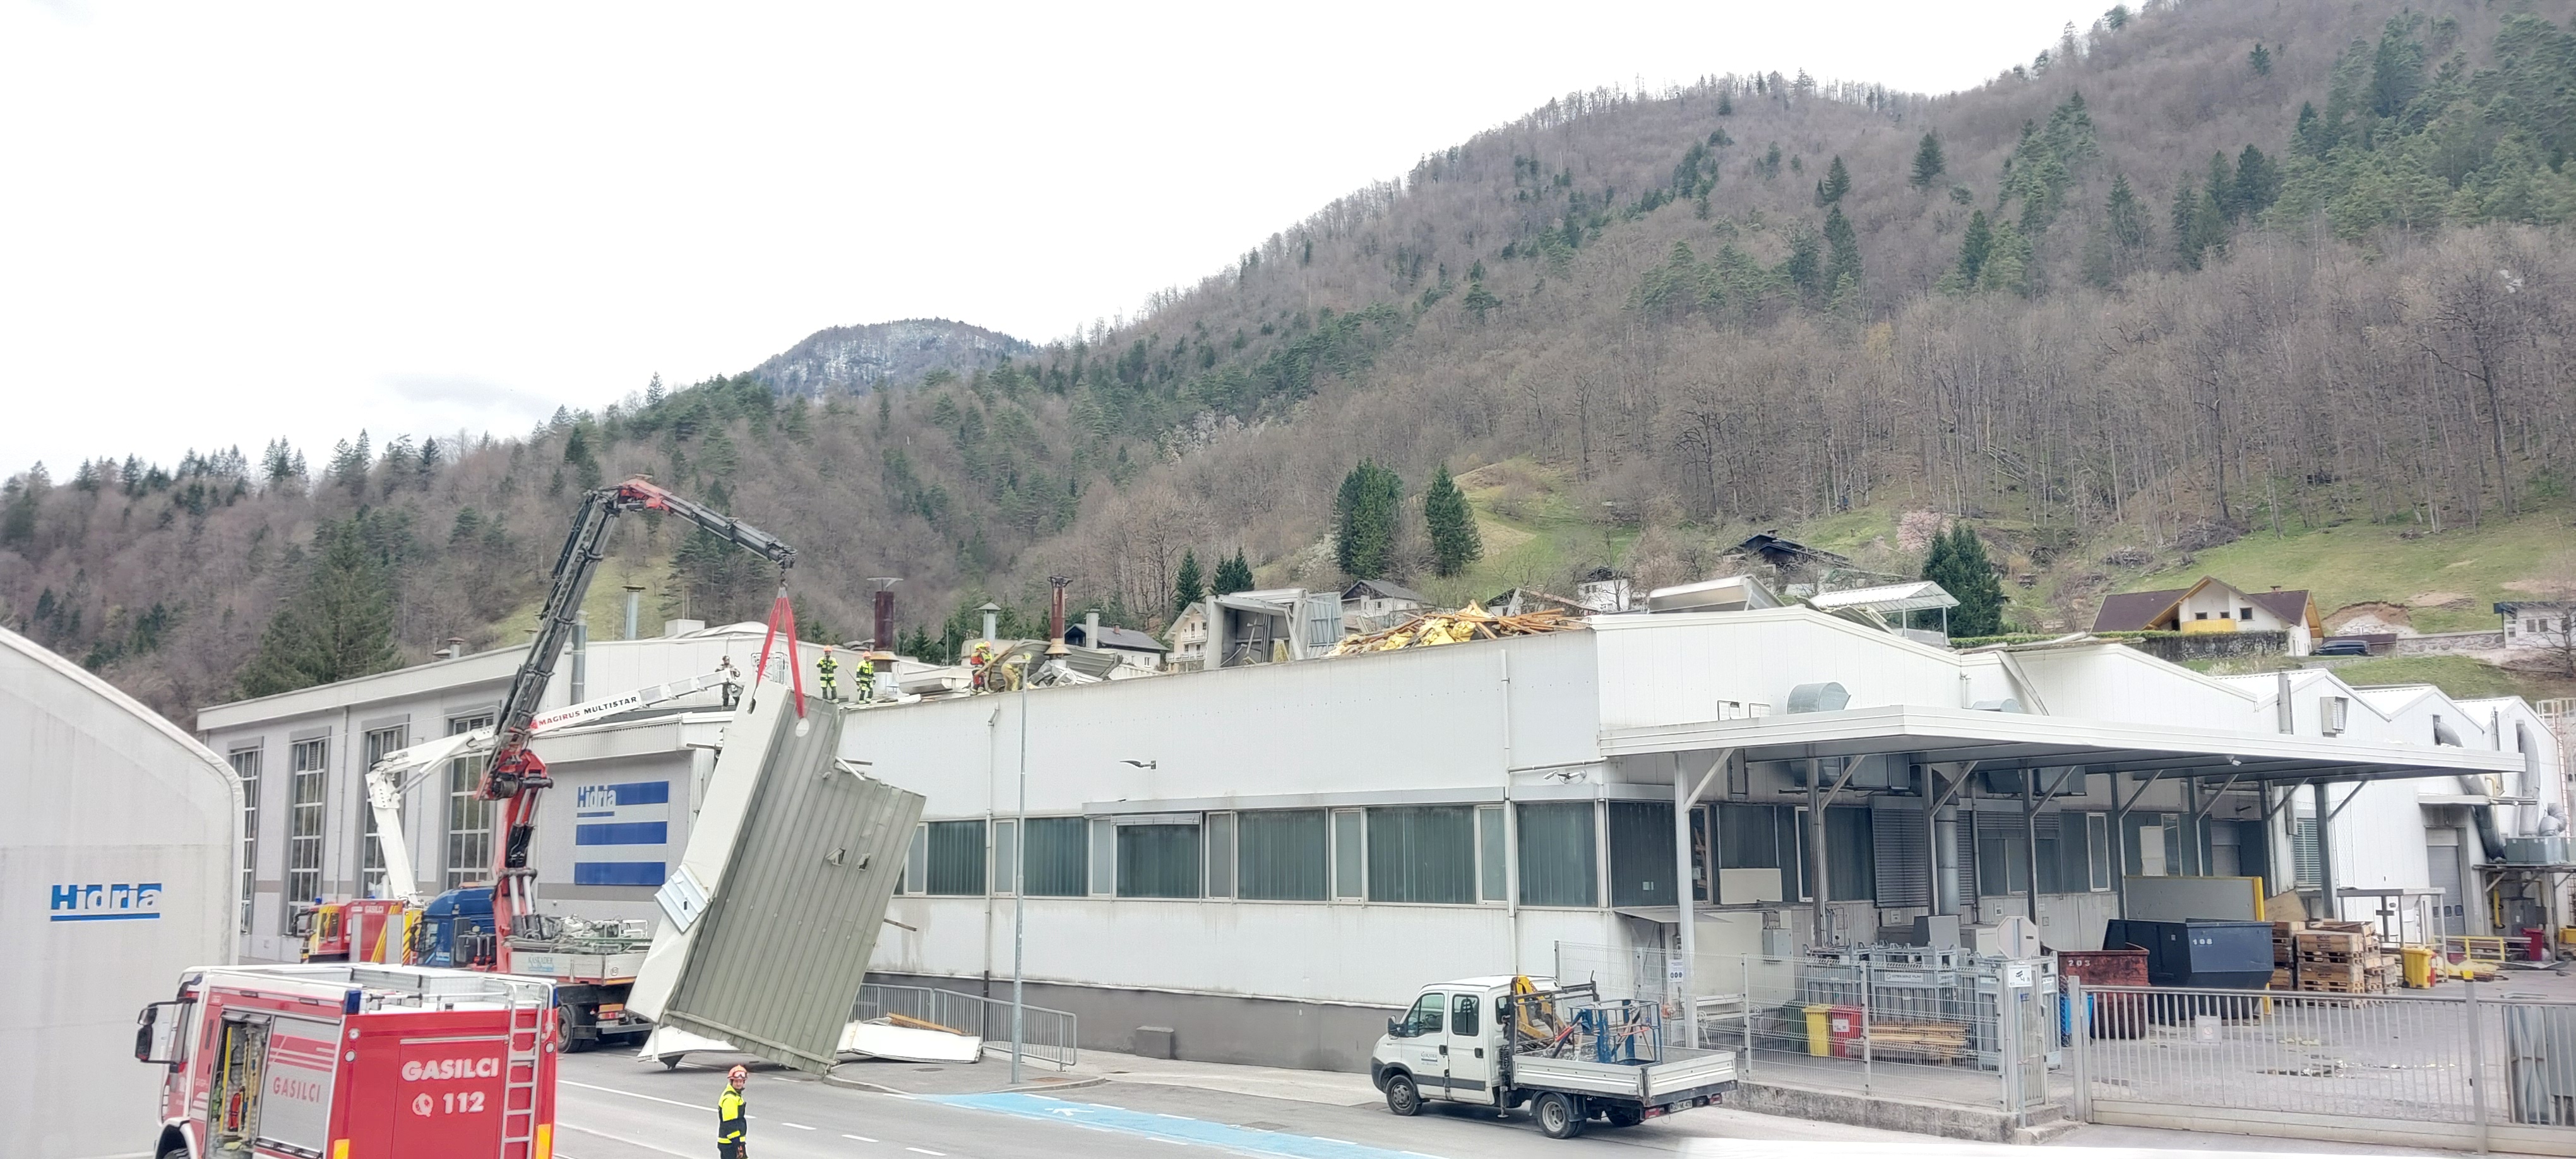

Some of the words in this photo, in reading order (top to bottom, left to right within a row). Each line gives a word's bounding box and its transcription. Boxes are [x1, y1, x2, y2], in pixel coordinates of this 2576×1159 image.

[539, 710, 580, 726] MAGIRUS
[584, 696, 637, 715] MULTISTAR
[577, 785, 616, 807] Hidria
[51, 883, 162, 910] Hidria
[402, 1057, 499, 1081] GASILCI
[273, 1076, 321, 1103] GASILCI
[443, 1091, 485, 1114] 112
